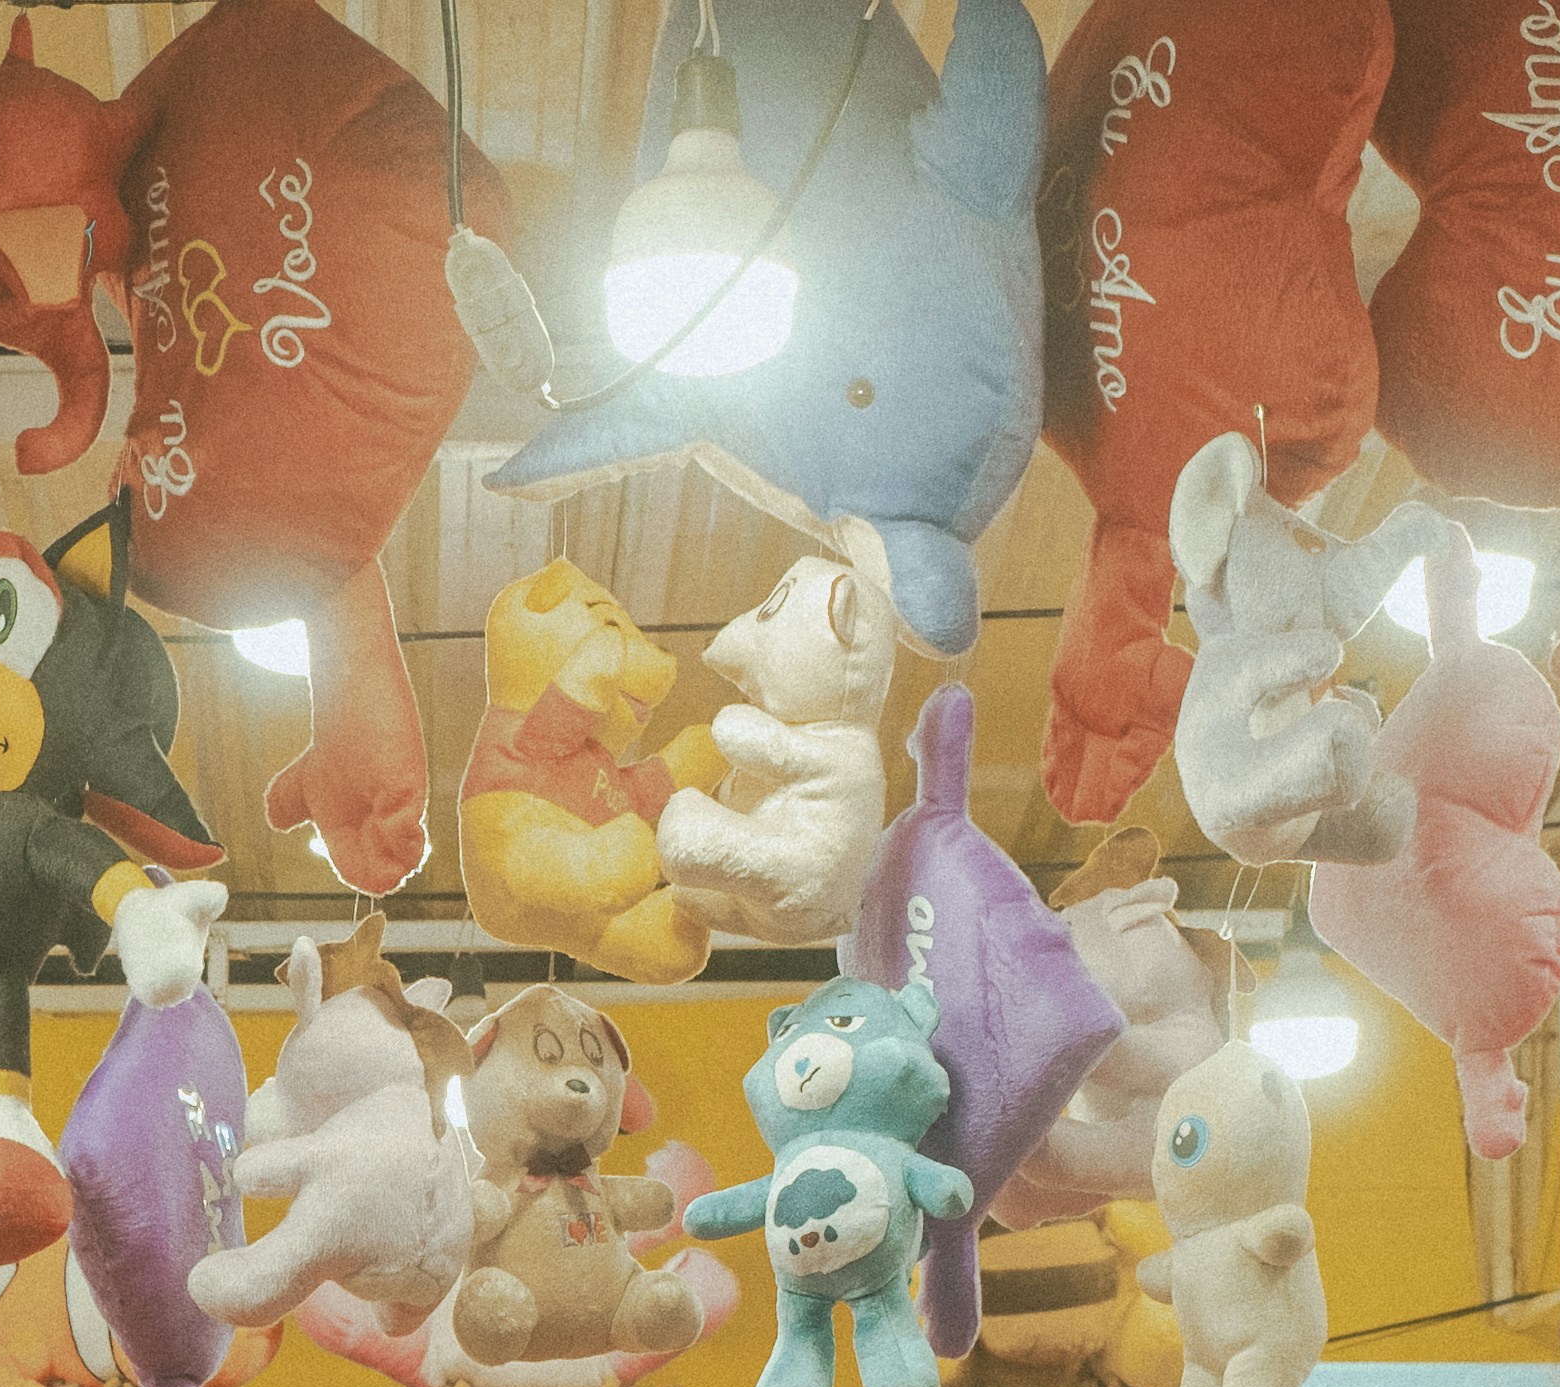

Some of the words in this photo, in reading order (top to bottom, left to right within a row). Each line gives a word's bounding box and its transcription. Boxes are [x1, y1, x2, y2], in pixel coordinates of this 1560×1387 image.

[1098, 34, 1177, 158] Eu
[133, 165, 178, 353] Amo
[251, 157, 332, 369] Você
[1086, 205, 1156, 415] Amo
[141, 398, 197, 521] Eu
[198, 1160, 227, 1256] AM
